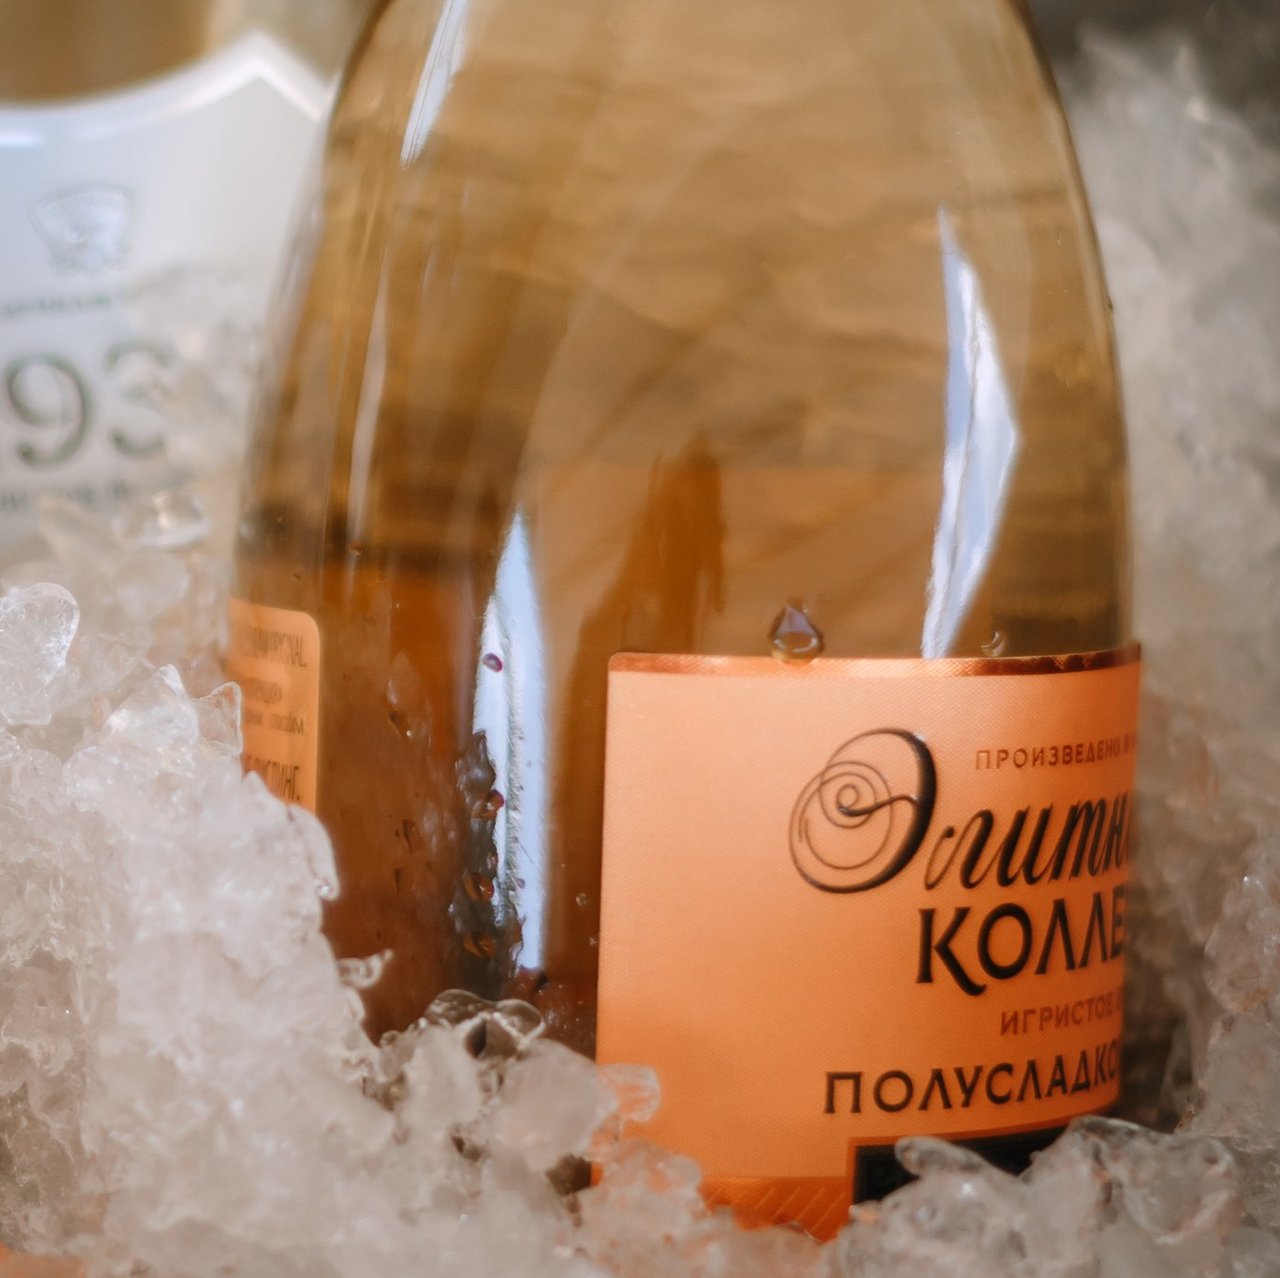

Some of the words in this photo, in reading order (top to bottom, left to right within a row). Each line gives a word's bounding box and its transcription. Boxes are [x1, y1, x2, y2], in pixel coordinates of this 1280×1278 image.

[975, 735, 1121, 770] ПРОИЗВЕДЕНО
[788, 727, 1133, 894] Элитн
[1000, 990, 1114, 1037] ИГРИСТОЕ
